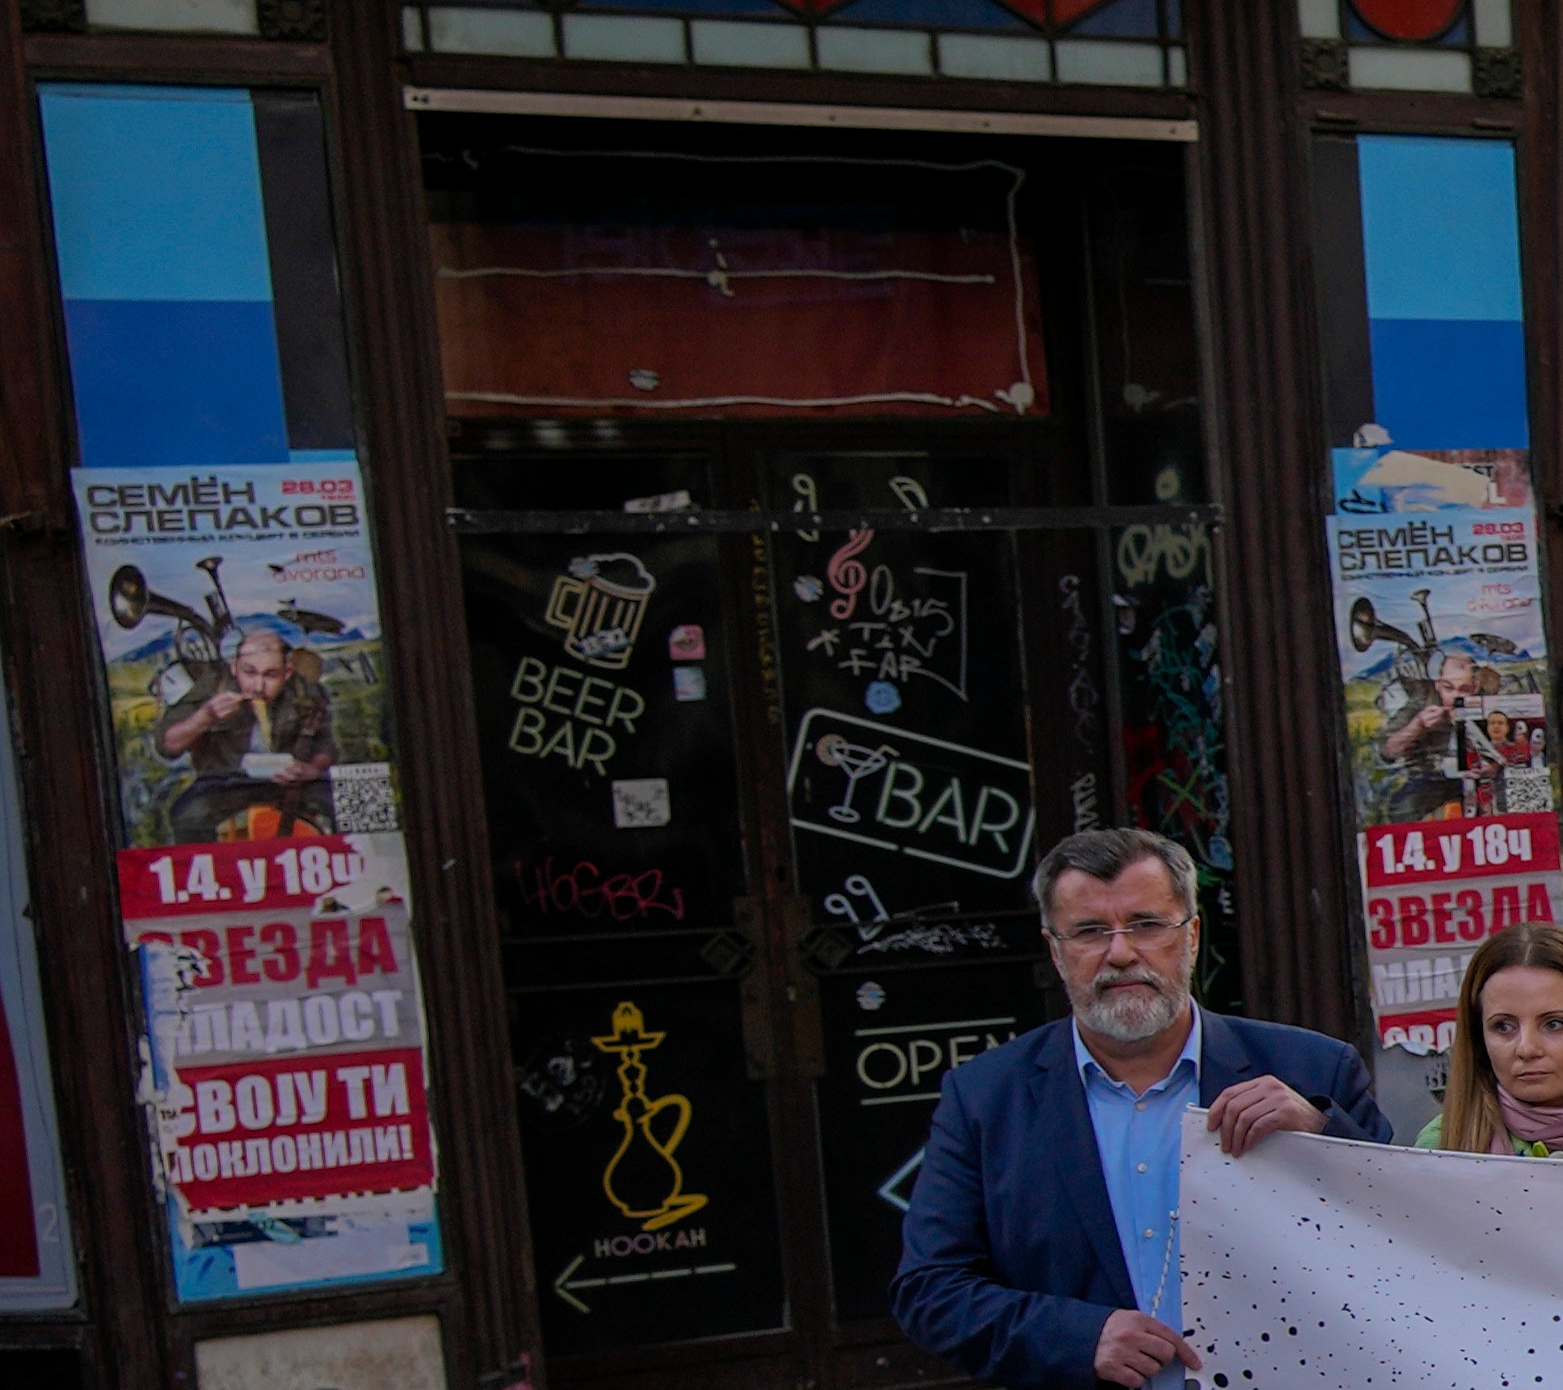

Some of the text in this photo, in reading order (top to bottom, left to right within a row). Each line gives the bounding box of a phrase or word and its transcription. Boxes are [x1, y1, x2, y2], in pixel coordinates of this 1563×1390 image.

[87, 474, 256, 508] СЕМЁН
[281, 479, 354, 495] 28.03
[90, 505, 360, 534] СЛЕПАКОВ
[1337, 520, 1454, 549] СЕМЁН
[1472, 522, 1525, 536] 28.03
[296, 549, 337, 564] mts
[1339, 543, 1528, 572] СЛЕПАКОВ
[509, 655, 647, 735] BEER
[507, 705, 617, 778] BAR
[874, 760, 1020, 855] BAR
[1375, 822, 1533, 875] 1.4. у 18ч
[150, 854, 231, 905] 1.4.
[237, 857, 267, 903] у
[1367, 882, 1556, 951] ЗВЕЗДА
[138, 915, 400, 990] ВЕЗДА
[856, 1031, 1018, 1090] OPE
[335, 1061, 412, 1121] ТИ
[593, 1227, 708, 1260] HOOKAH
